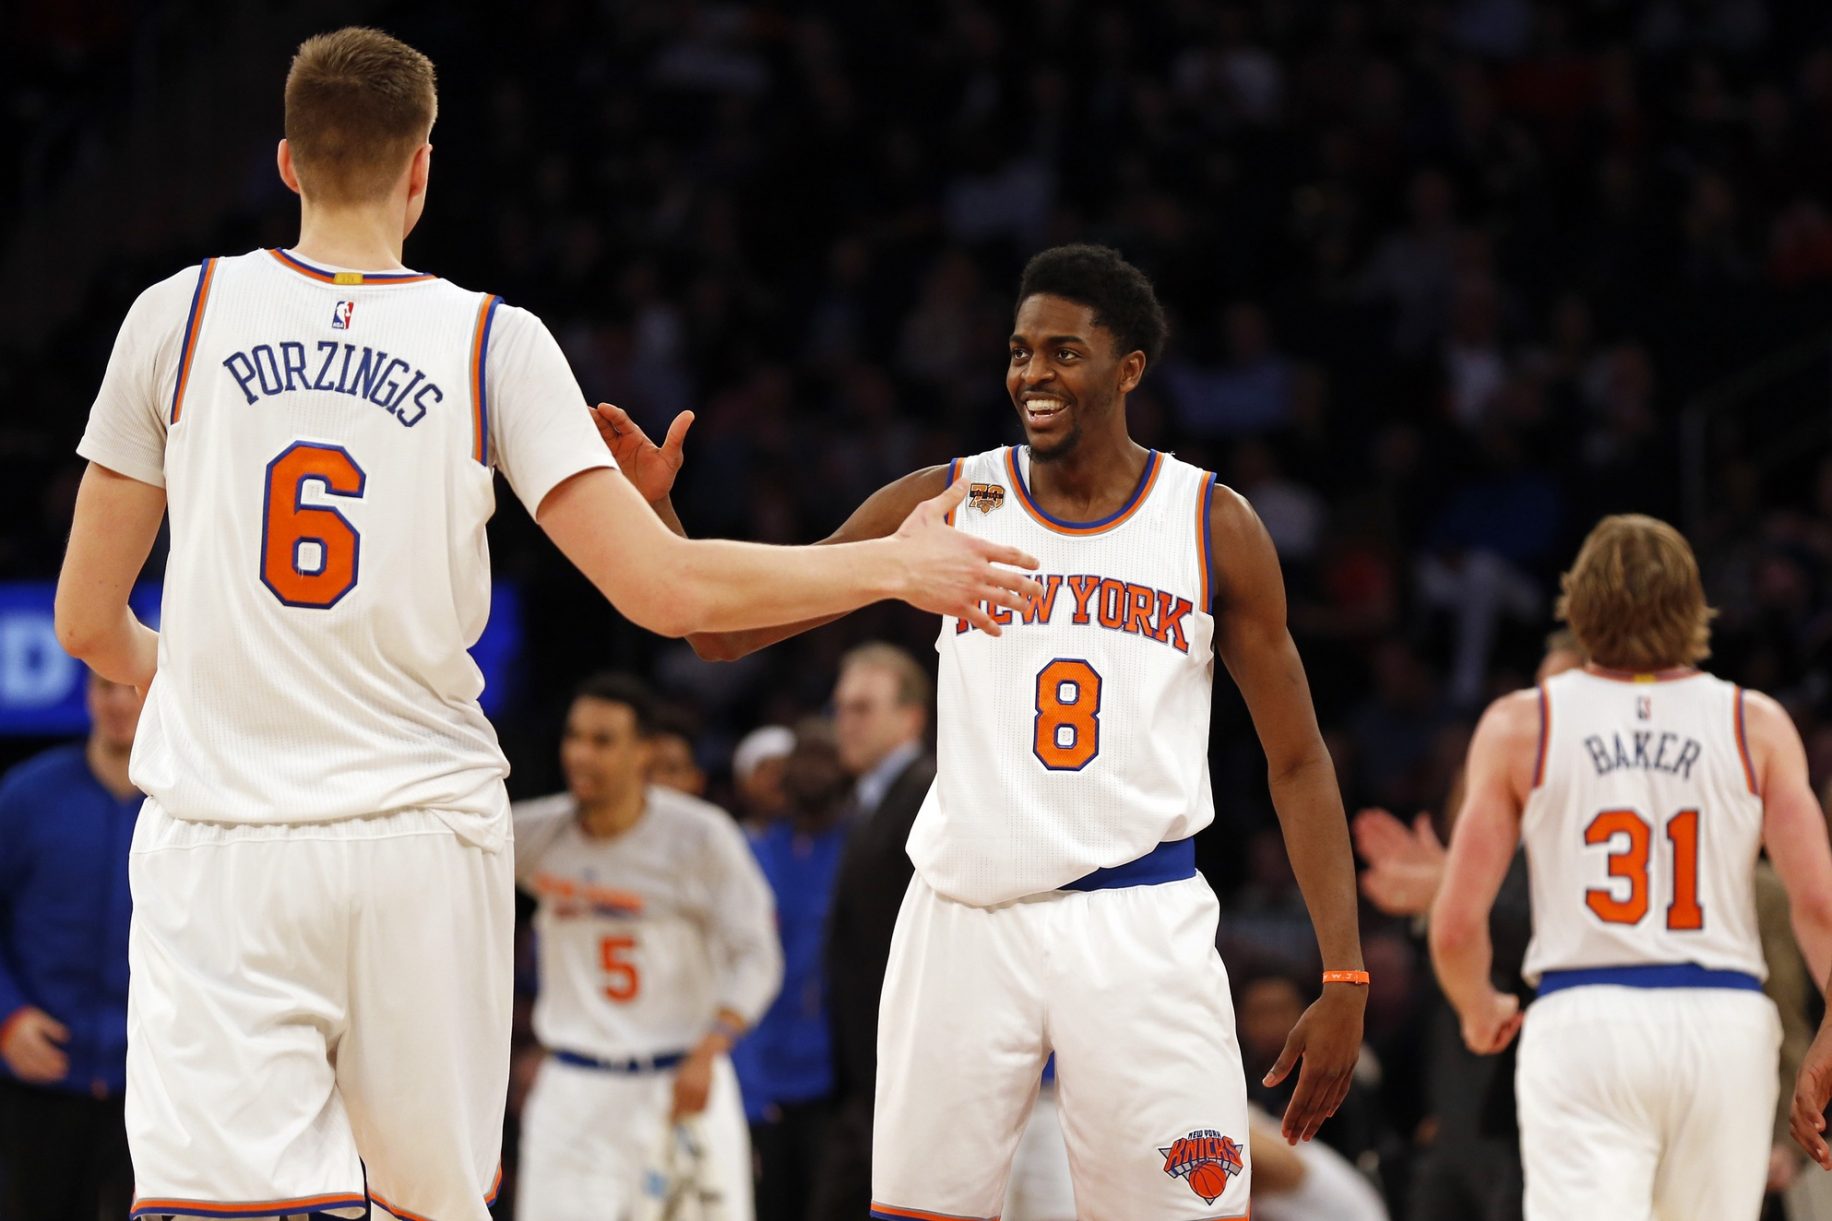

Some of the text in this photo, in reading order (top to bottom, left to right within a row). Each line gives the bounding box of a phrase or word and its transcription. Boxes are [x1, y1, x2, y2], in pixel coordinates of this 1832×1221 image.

[222, 340, 443, 428] PORZINGIS
[259, 439, 367, 610] 6
[1067, 574, 1194, 655] YORK
[1033, 657, 1102, 771] 8
[1584, 730, 1702, 779] BAKER
[1584, 808, 1703, 930] 31
[599, 935, 640, 1004] 5
[1163, 1136, 1244, 1177] KNICKS
[1187, 1129, 1222, 1140] NEW YORK
